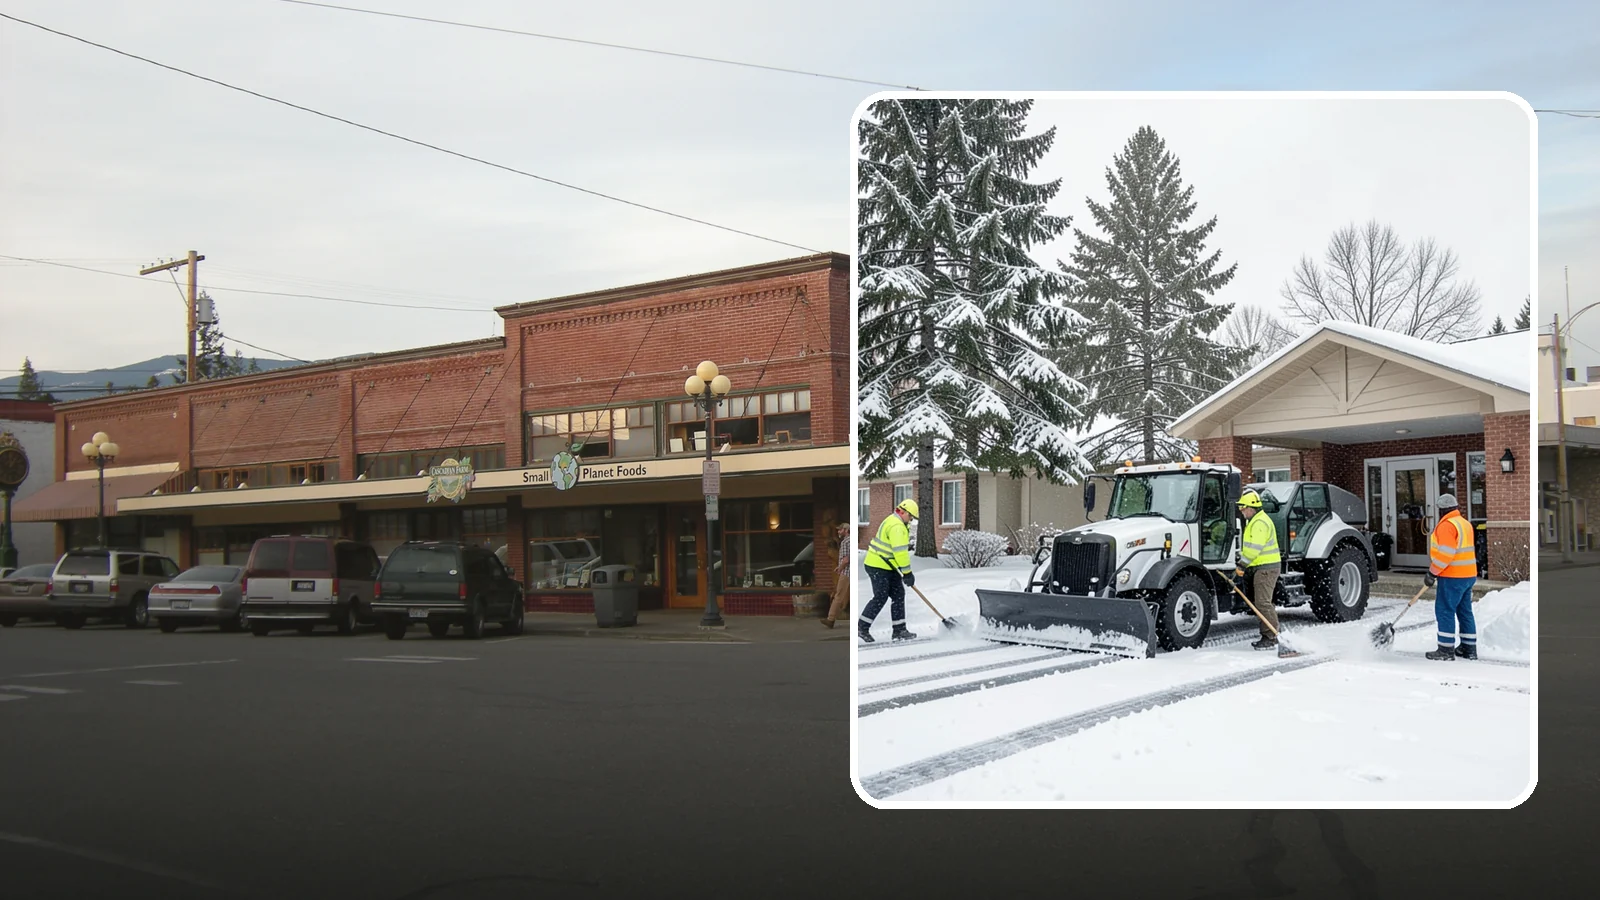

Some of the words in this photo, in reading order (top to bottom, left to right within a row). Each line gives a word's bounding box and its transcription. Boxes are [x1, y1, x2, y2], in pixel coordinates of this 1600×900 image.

[523, 470, 548, 482] Small
[583, 467, 614, 480] Planet
[617, 464, 647, 476] Foods
